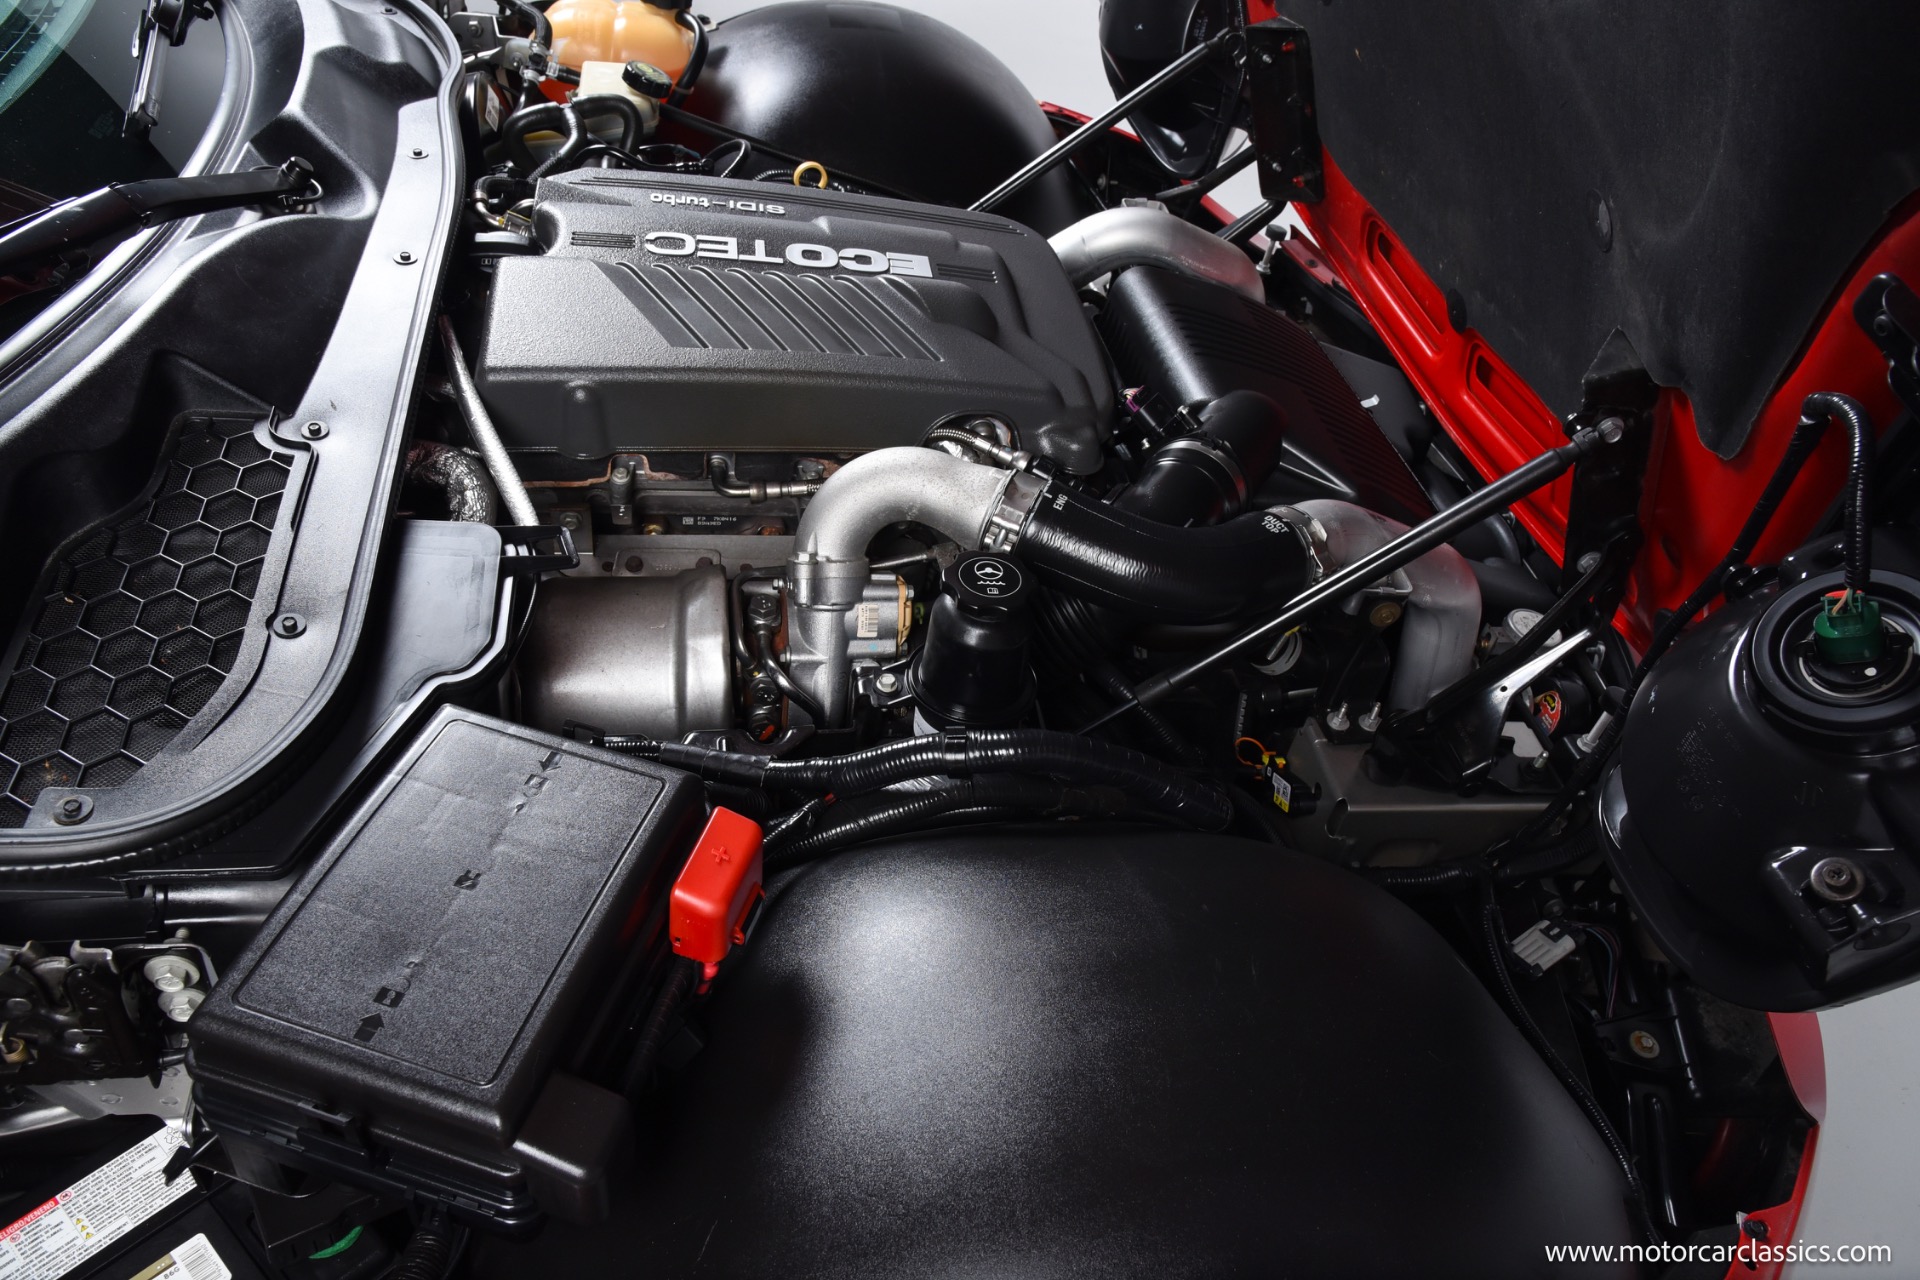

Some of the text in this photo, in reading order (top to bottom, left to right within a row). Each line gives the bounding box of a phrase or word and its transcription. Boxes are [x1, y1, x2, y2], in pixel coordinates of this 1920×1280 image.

[650, 193, 785, 214] SIDI-turbo
[645, 231, 933, 278] ECOTEC
[1053, 494, 1068, 511] ENG
[1261, 520, 1279, 533] TOP
[1264, 515, 1290, 533] DUCT
[163, 1266, 180, 1280] 86G
